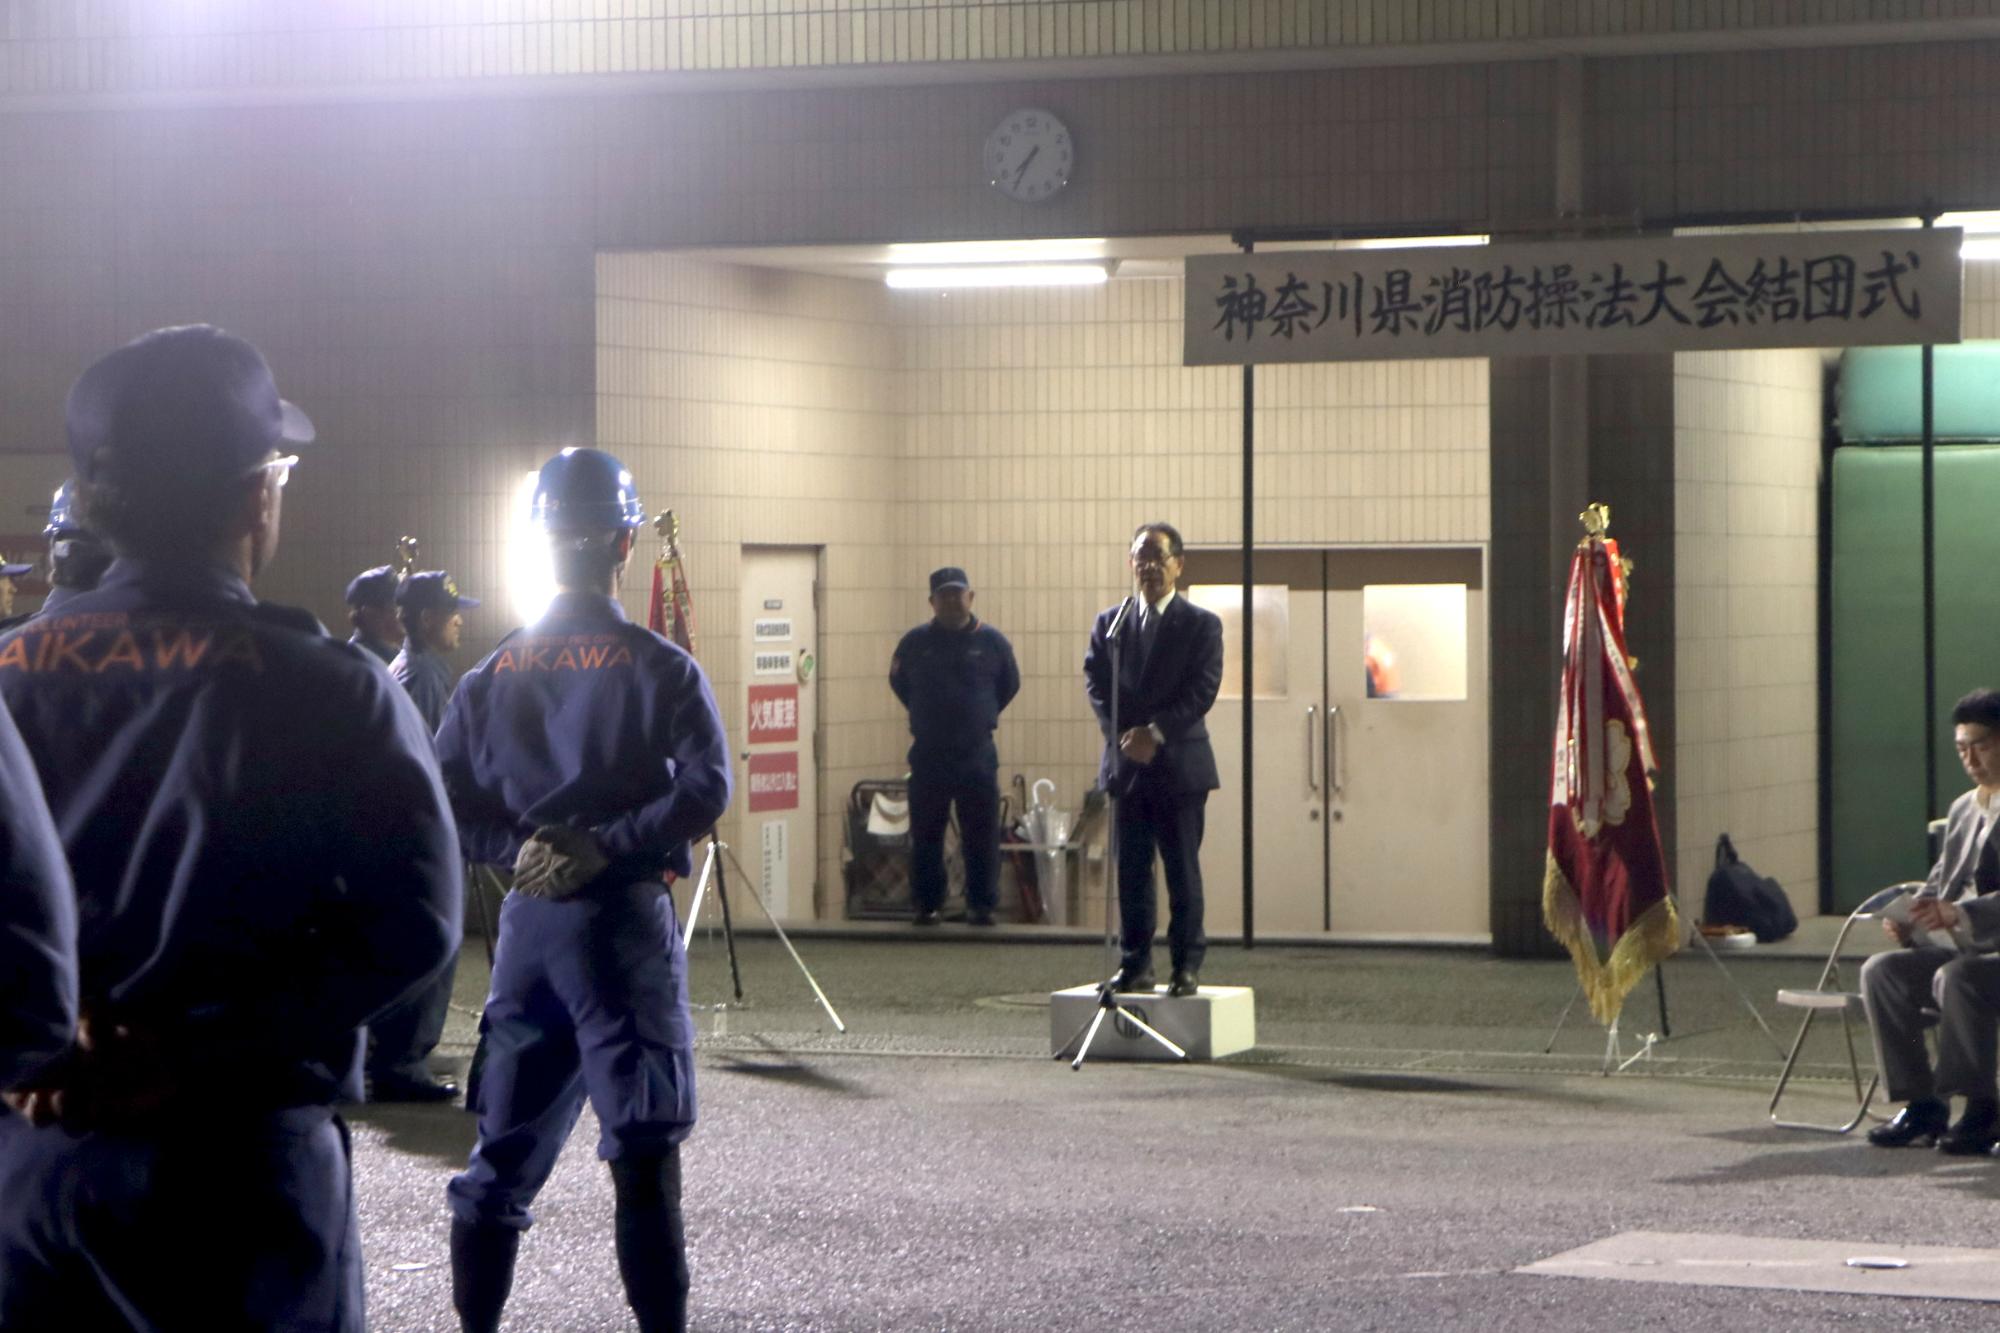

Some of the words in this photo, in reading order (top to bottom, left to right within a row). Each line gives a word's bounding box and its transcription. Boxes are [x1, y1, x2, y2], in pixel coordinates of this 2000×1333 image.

[1213, 250, 1921, 341] 神奈川県消防操法大会結団式
[0, 630, 263, 673] AIKAWA
[494, 645, 633, 674] AIKAWA
